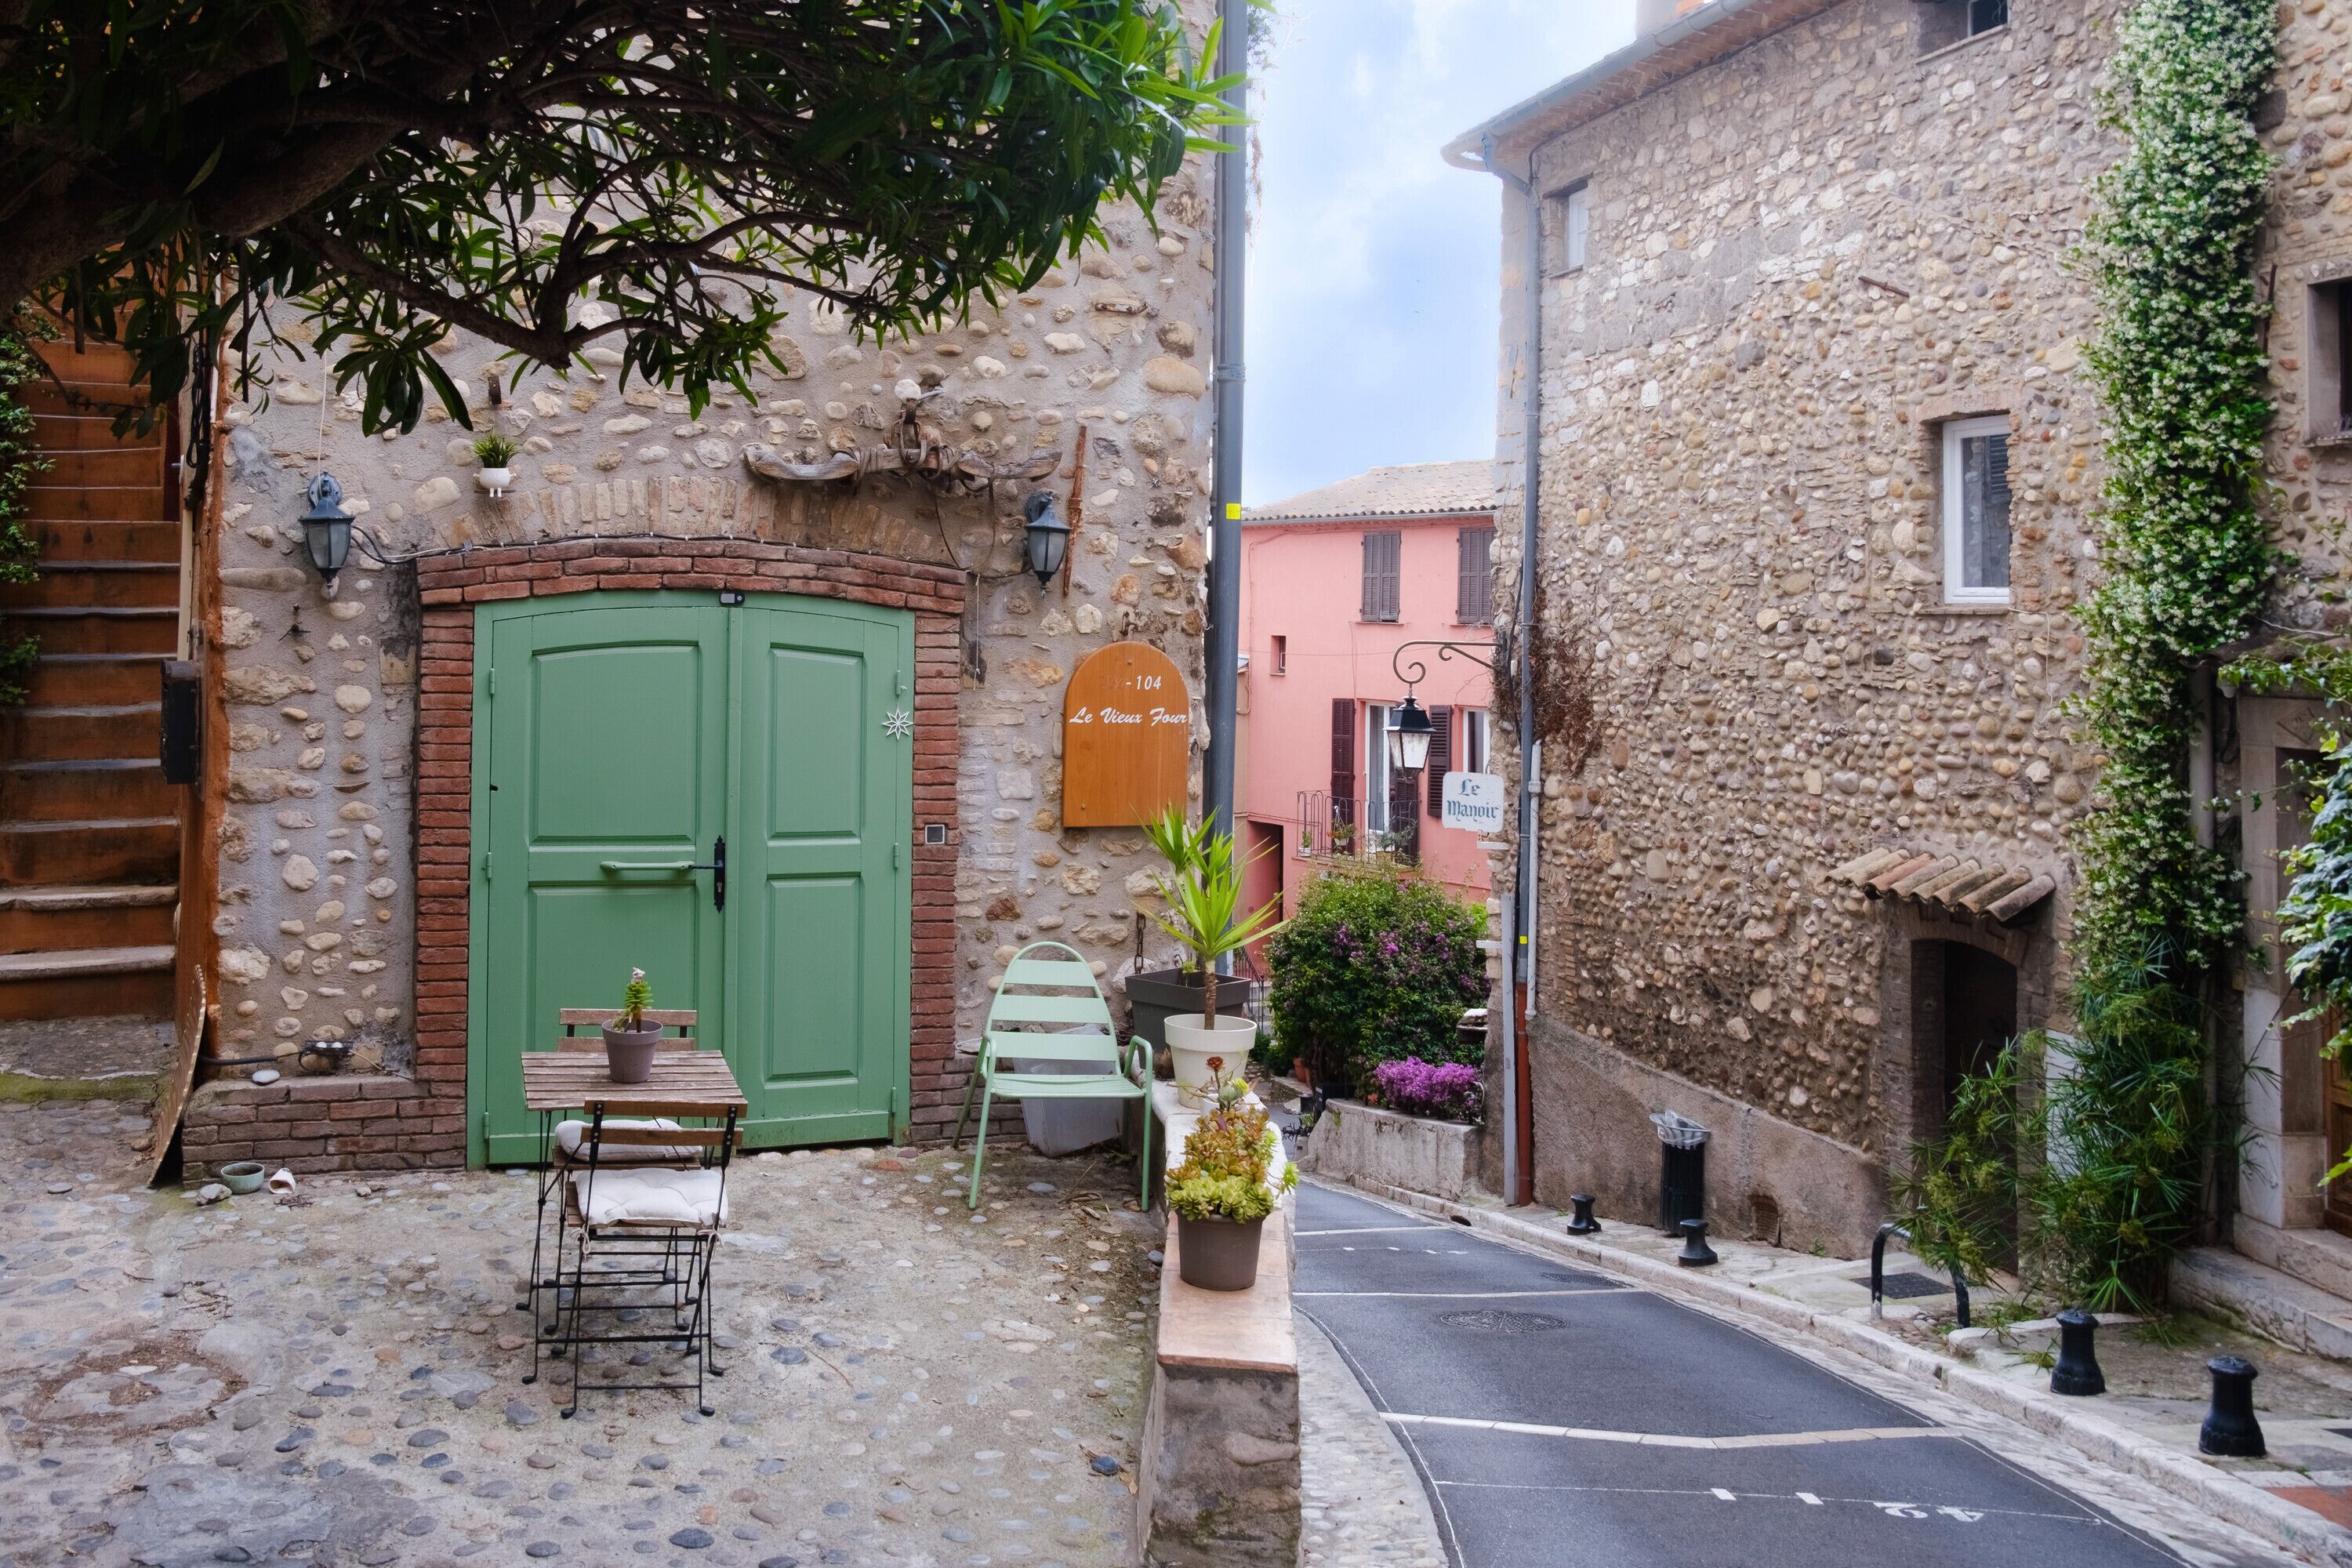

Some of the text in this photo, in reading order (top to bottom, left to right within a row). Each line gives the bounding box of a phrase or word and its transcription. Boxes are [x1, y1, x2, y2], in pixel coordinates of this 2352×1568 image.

[1069, 706, 1188, 726] Le Vieux Four
[1458, 779, 1480, 796] Le
[1446, 800, 1499, 822] Manoir
